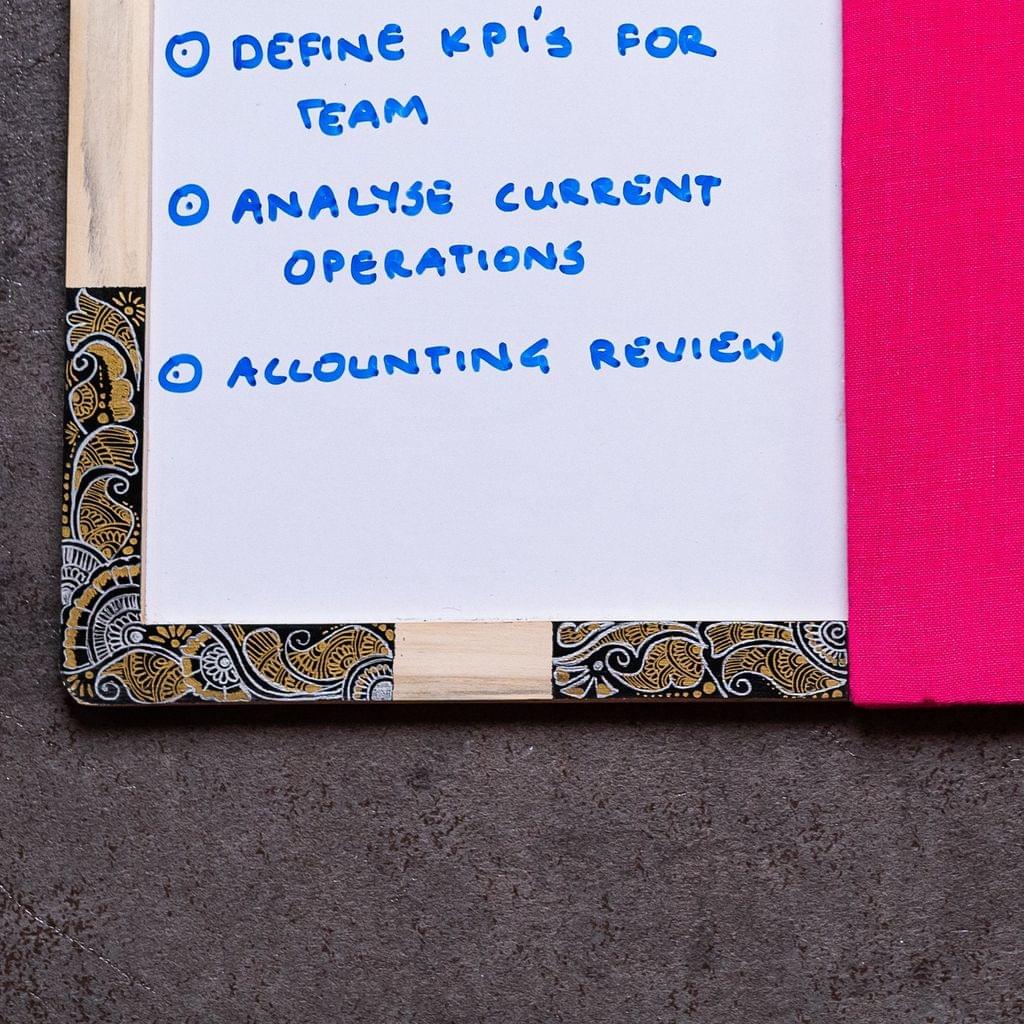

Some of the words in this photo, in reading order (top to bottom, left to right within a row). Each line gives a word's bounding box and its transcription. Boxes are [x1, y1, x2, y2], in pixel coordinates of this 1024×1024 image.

[232, 23, 405, 71] DEFINE
[617, 23, 716, 59] FOR
[297, 95, 429, 137] TEAM
[231, 179, 453, 224] ANALYSE
[495, 174, 721, 212] CURRENT
[283, 240, 585, 285] OPERATIONS
[226, 337, 550, 389] ACCOUNTING
[589, 331, 784, 371] REVIEW
